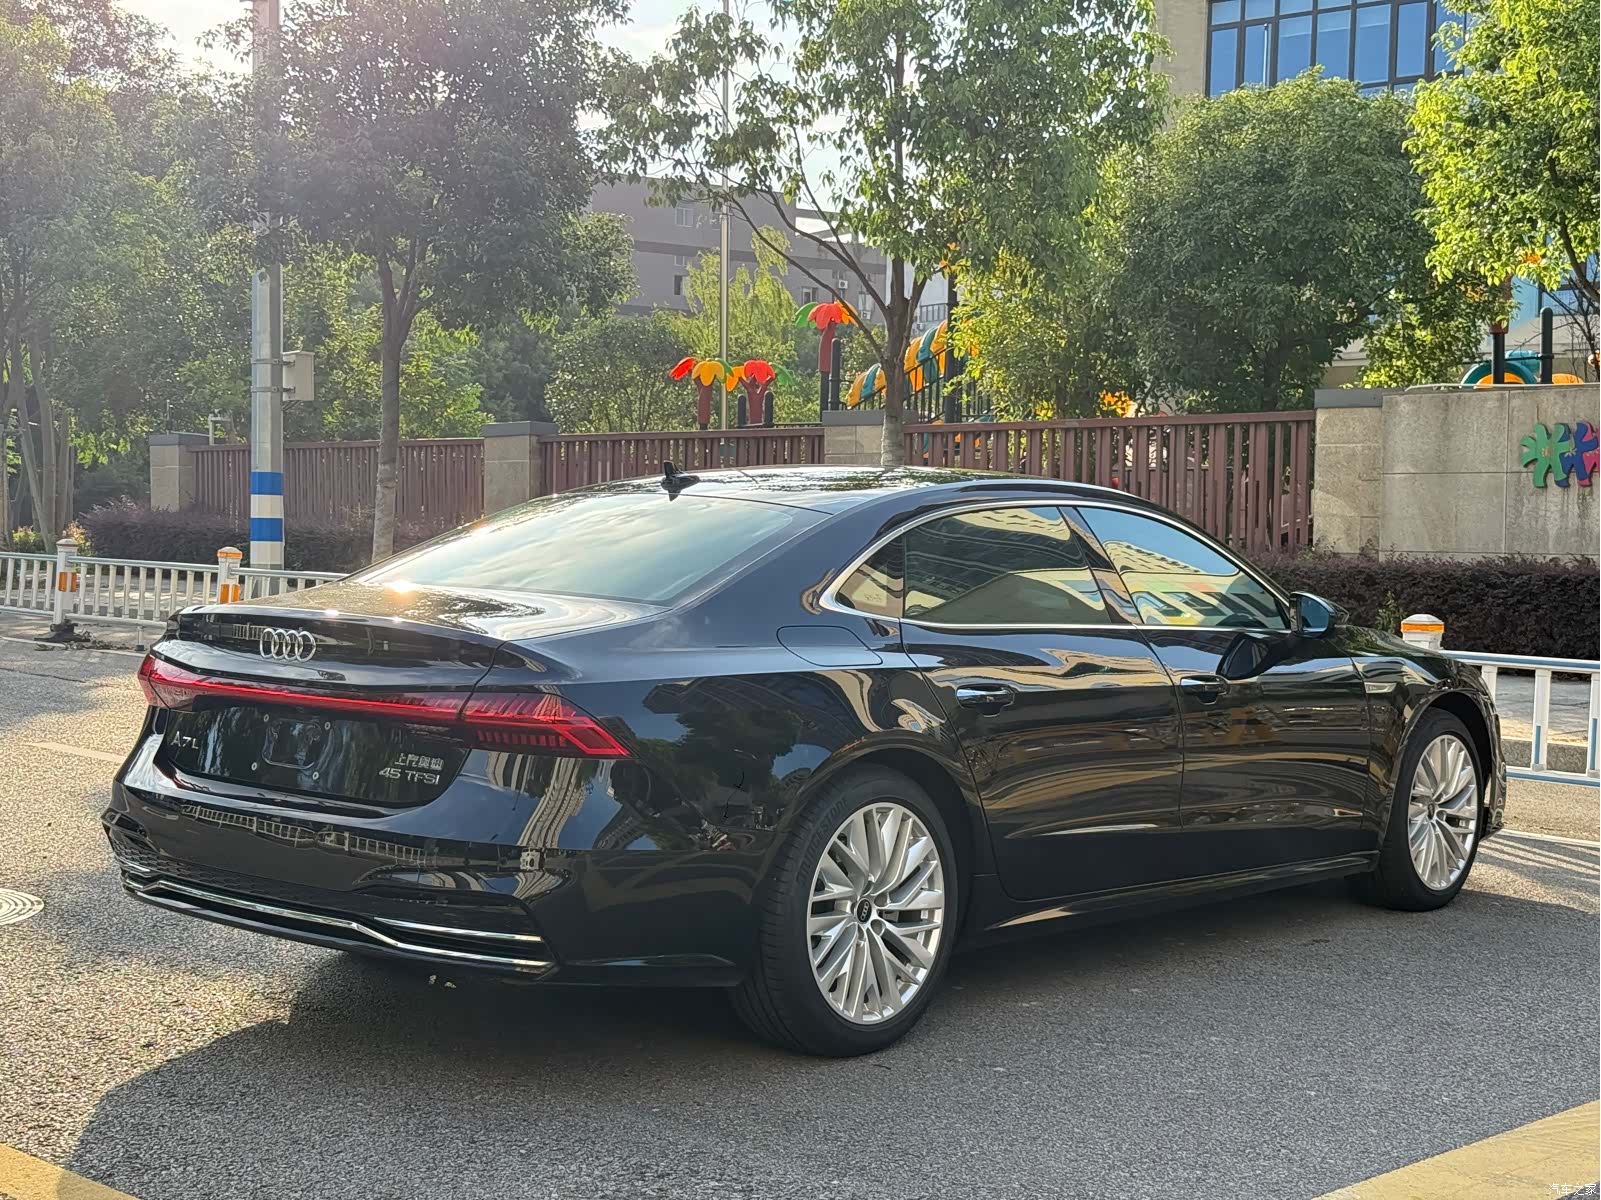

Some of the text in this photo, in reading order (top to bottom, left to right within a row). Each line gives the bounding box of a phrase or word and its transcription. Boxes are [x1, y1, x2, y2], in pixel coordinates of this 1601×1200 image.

[170, 730, 199, 750] A7L
[378, 767, 440, 785] 45 TFSI
